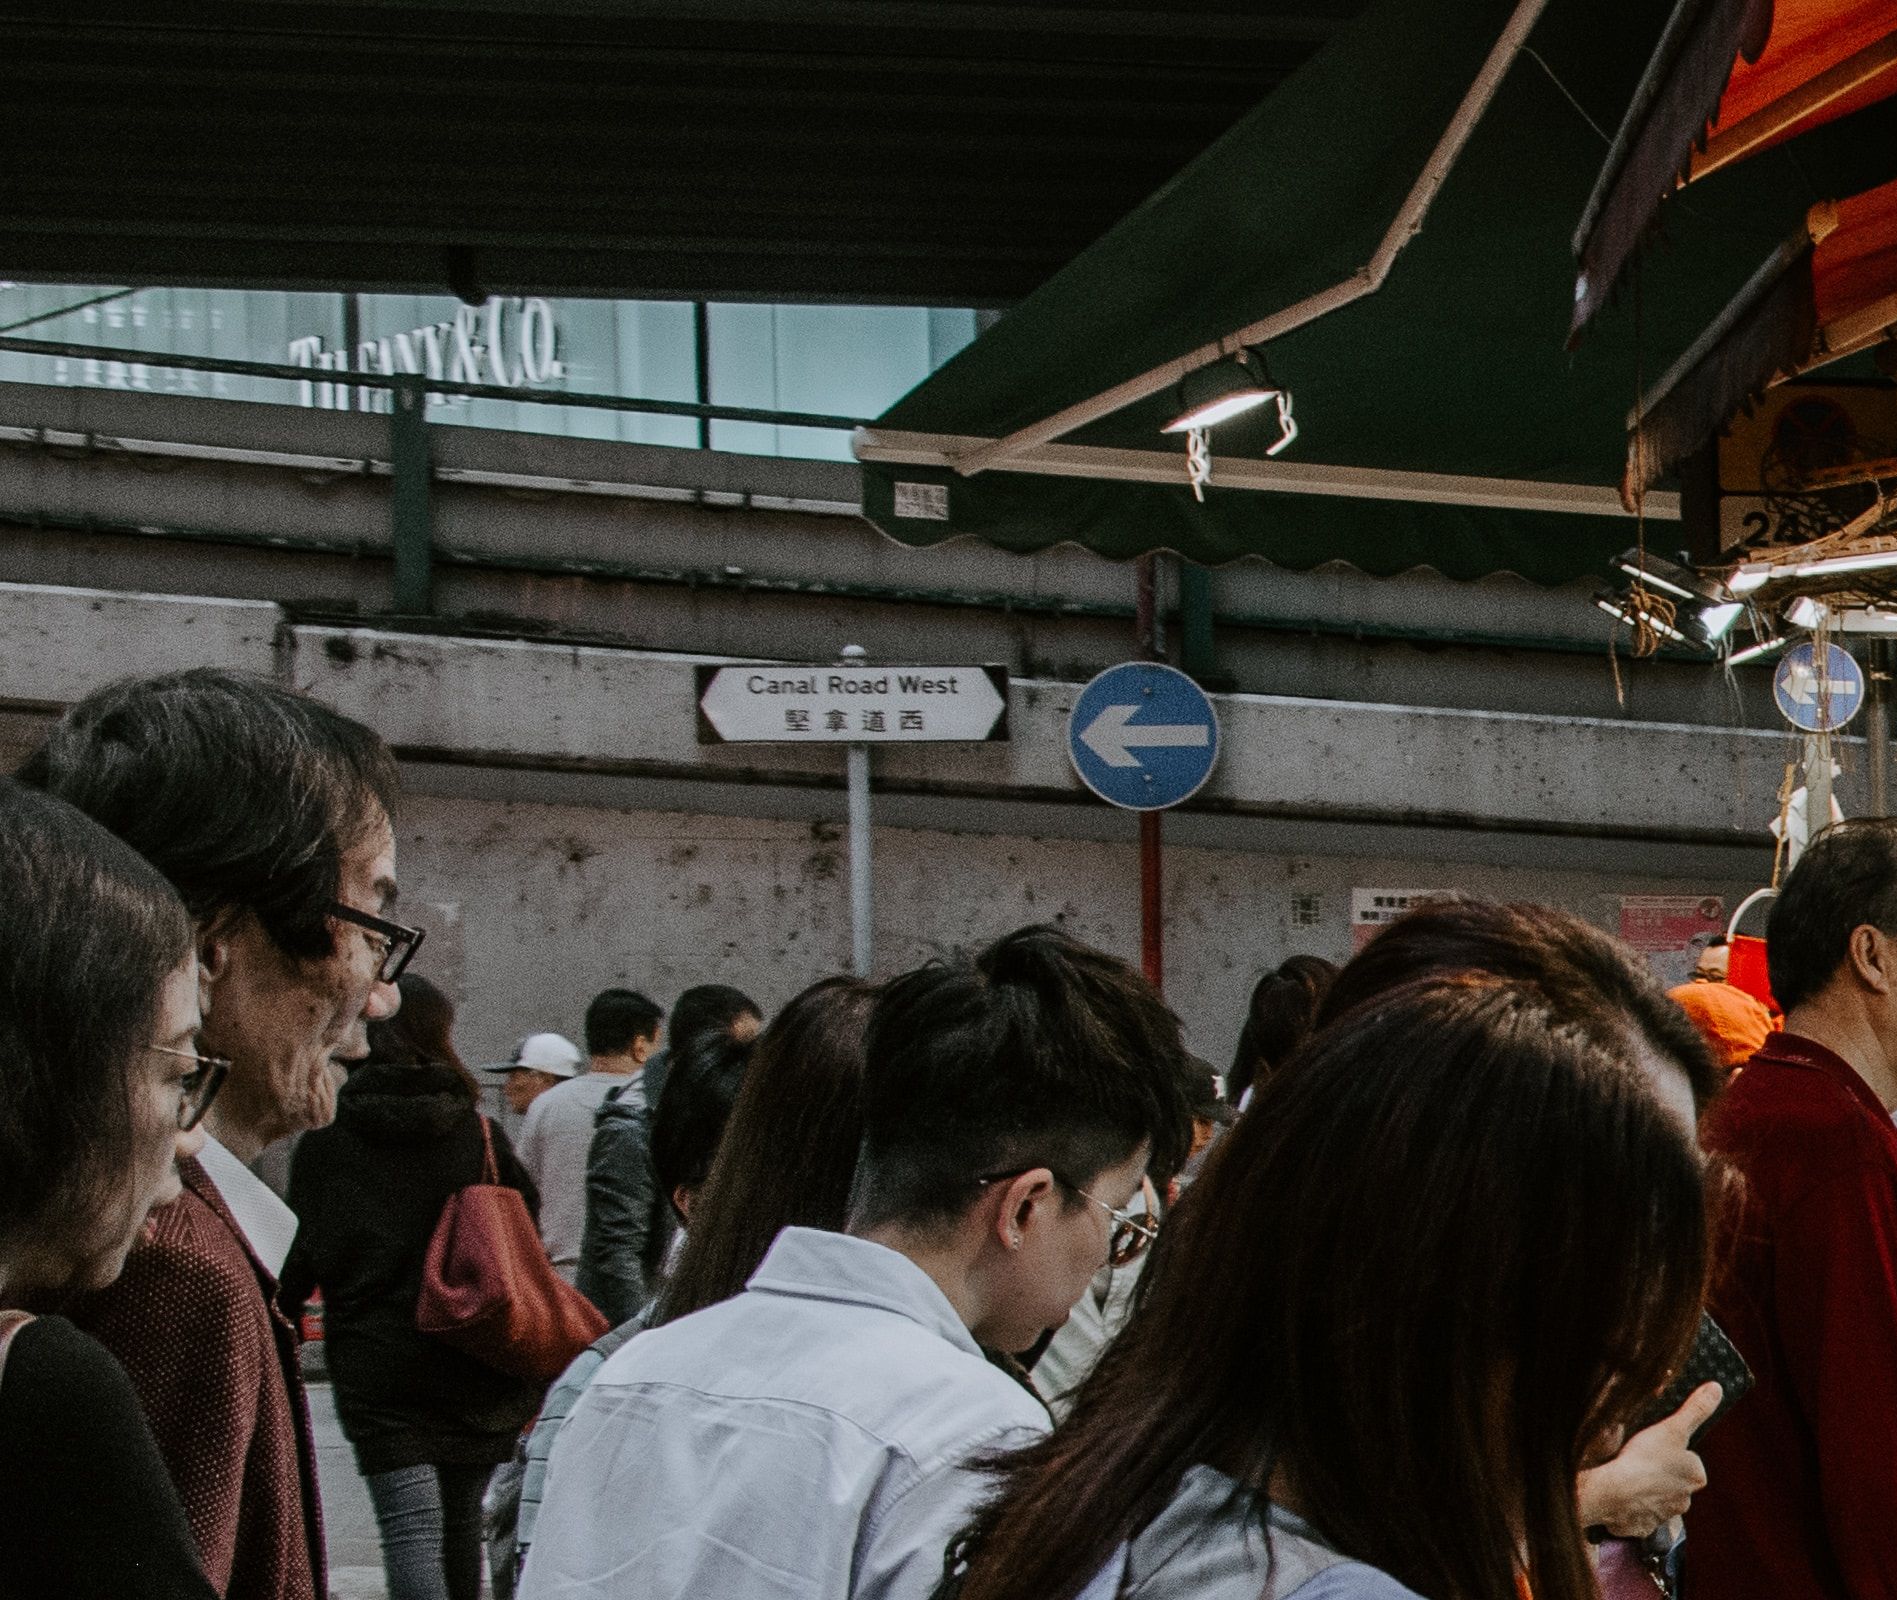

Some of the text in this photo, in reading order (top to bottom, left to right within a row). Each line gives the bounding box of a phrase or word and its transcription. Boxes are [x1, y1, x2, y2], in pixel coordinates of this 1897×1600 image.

[748, 675, 958, 695] Canal Road West
[785, 709, 923, 733] 堅拿道西
